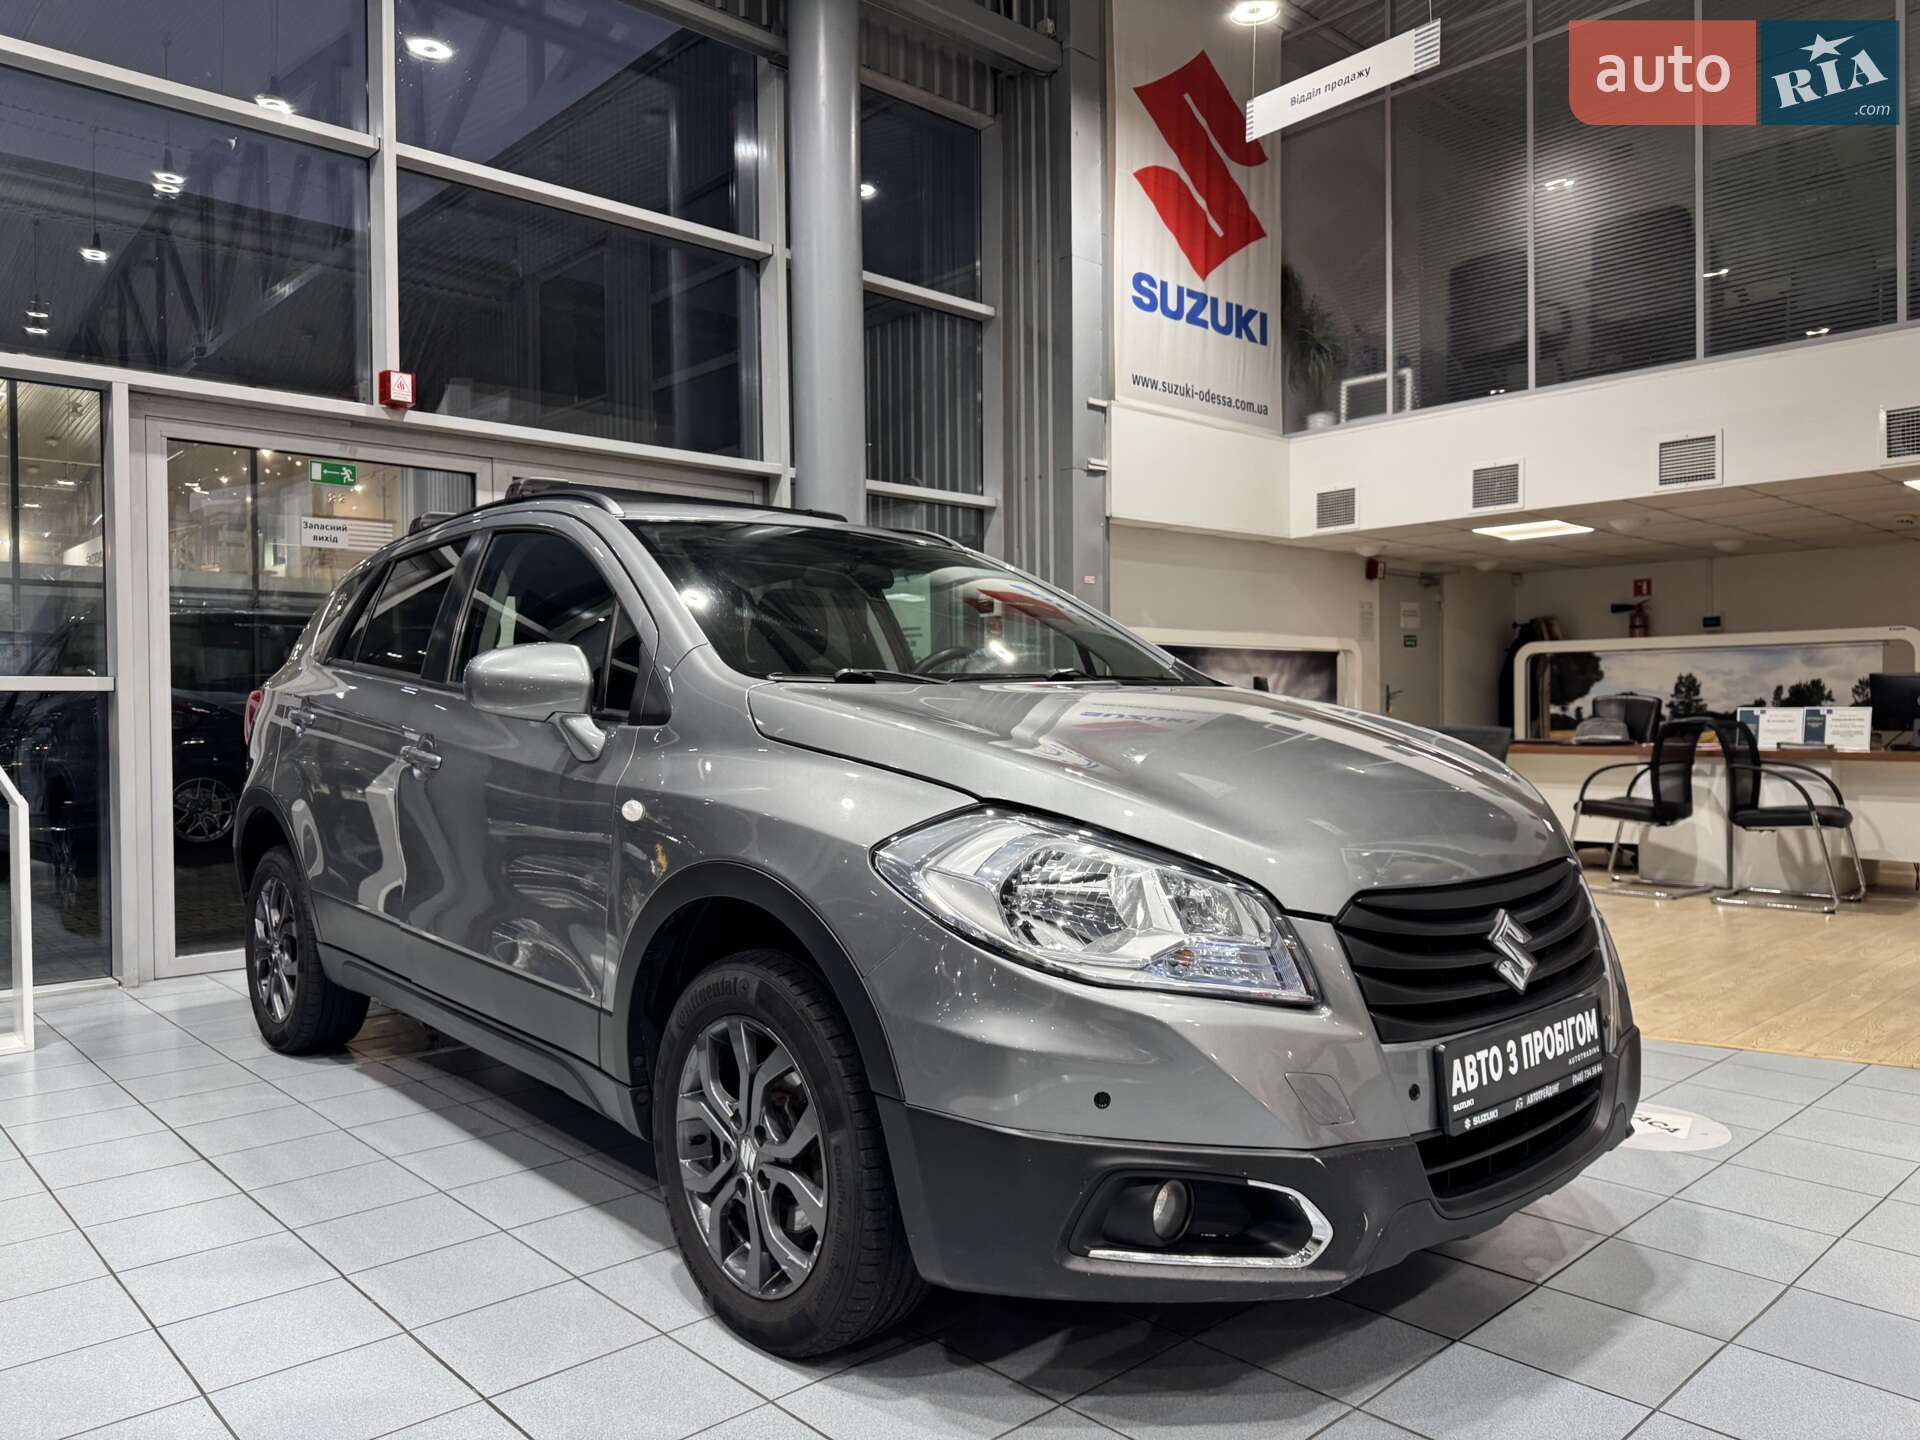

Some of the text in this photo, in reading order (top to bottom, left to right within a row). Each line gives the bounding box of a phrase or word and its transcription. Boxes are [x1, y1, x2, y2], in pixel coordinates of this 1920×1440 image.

[1290, 66, 1371, 107] Відділ продажу
[1131, 271, 1268, 346] SUZUKI
[1131, 372, 1269, 416] www.suzuki-odessa.com.ua
[302, 521, 347, 532] Запасний
[312, 533, 338, 544] вихід
[1452, 1045, 1503, 1097] АВТО
[1520, 1007, 1599, 1070] ПРОБІГОМ
[1453, 1098, 1475, 1112] SUZUKI
[1473, 1109, 1499, 1126] SUZUKI
